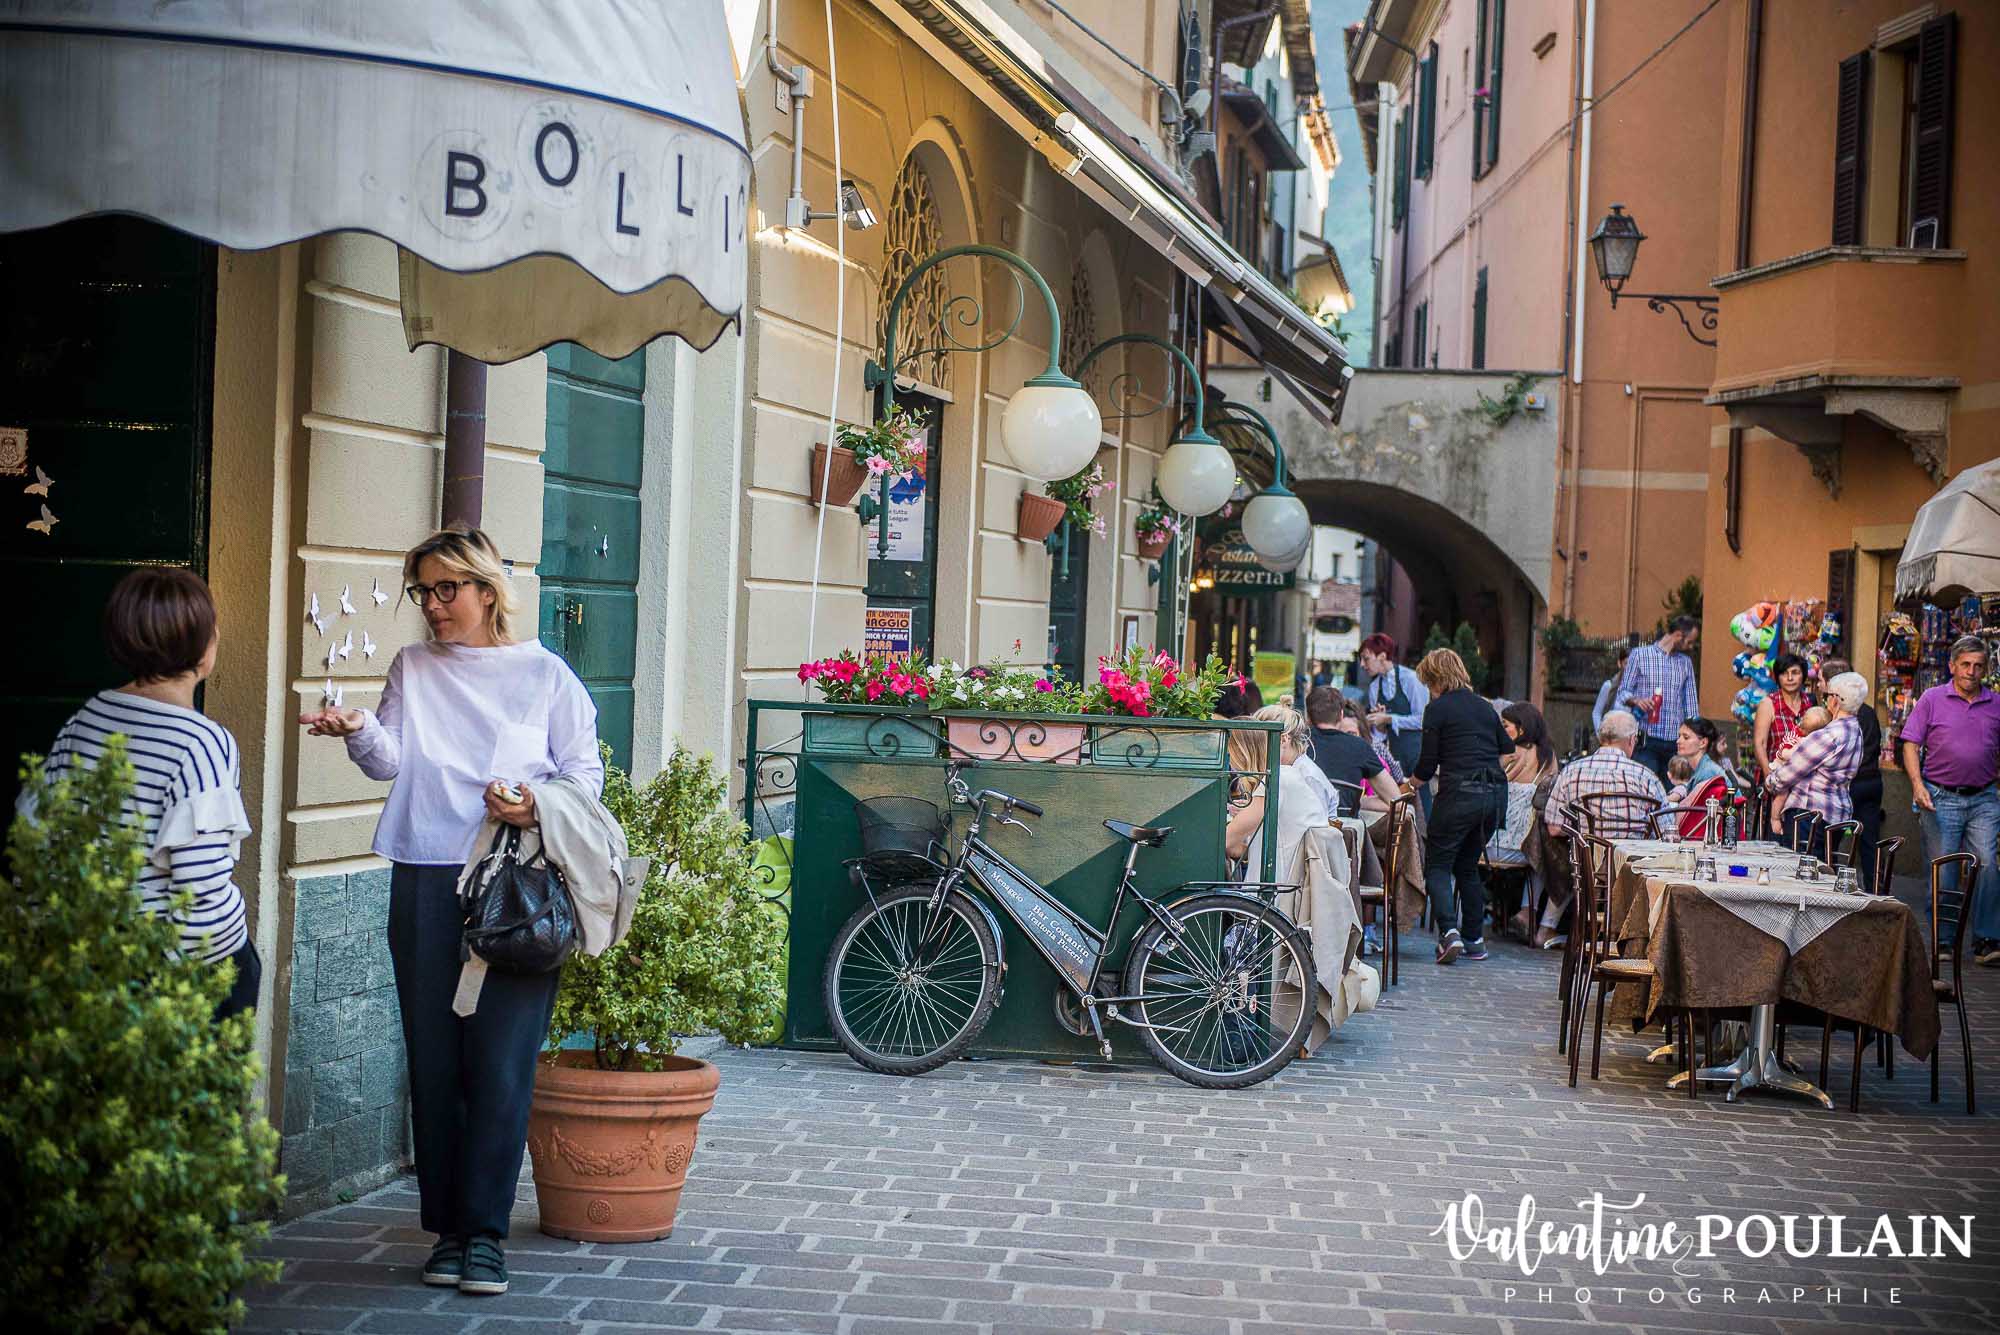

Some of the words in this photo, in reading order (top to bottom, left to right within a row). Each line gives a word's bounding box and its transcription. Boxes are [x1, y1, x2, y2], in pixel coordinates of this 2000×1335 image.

[1200, 565, 1285, 585] izzeria
[990, 870, 1024, 903] Menaggio
[1031, 904, 1048, 921] Bar
[1027, 910, 1056, 941] Trattoria
[1057, 939, 1085, 965] Pizzeria
